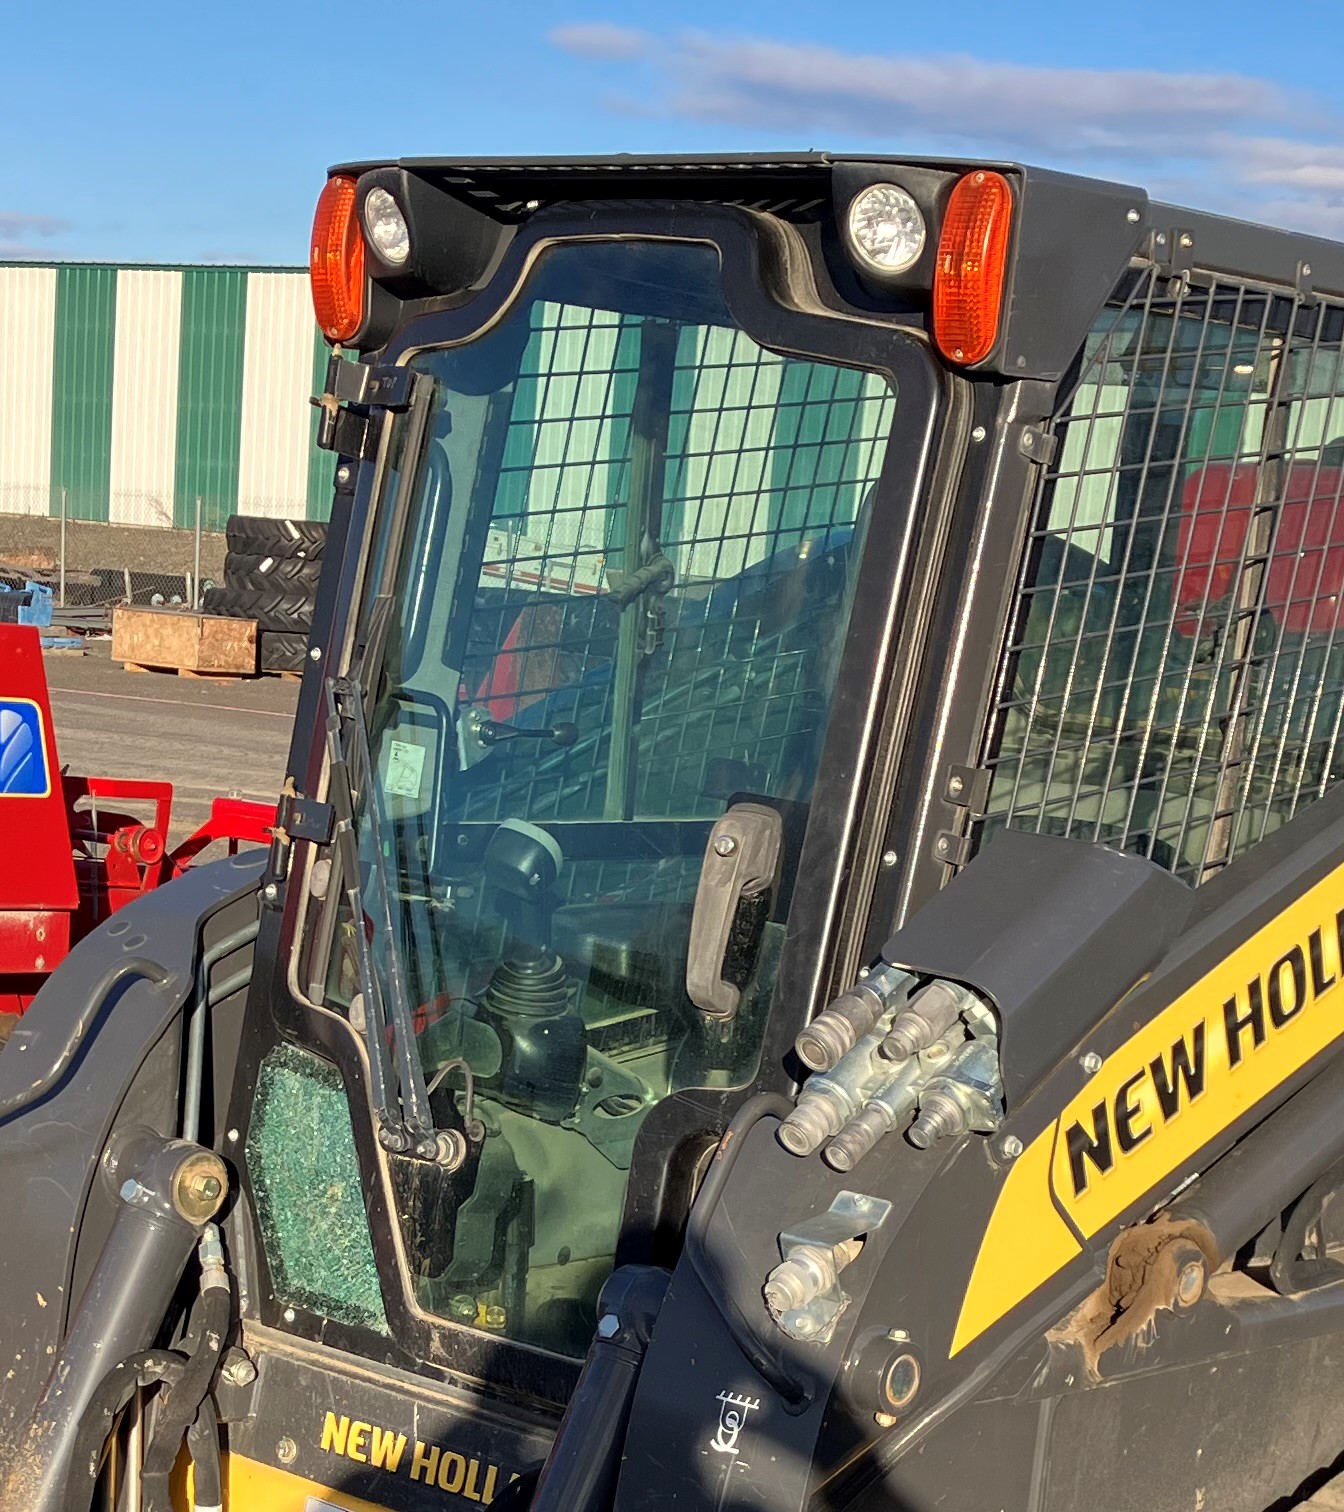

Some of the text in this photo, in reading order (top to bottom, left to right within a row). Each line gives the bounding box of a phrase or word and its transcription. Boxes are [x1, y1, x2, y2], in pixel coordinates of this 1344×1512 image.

[1063, 1022, 1207, 1198] NEW
[320, 1410, 521, 1505] NEW HOLL
